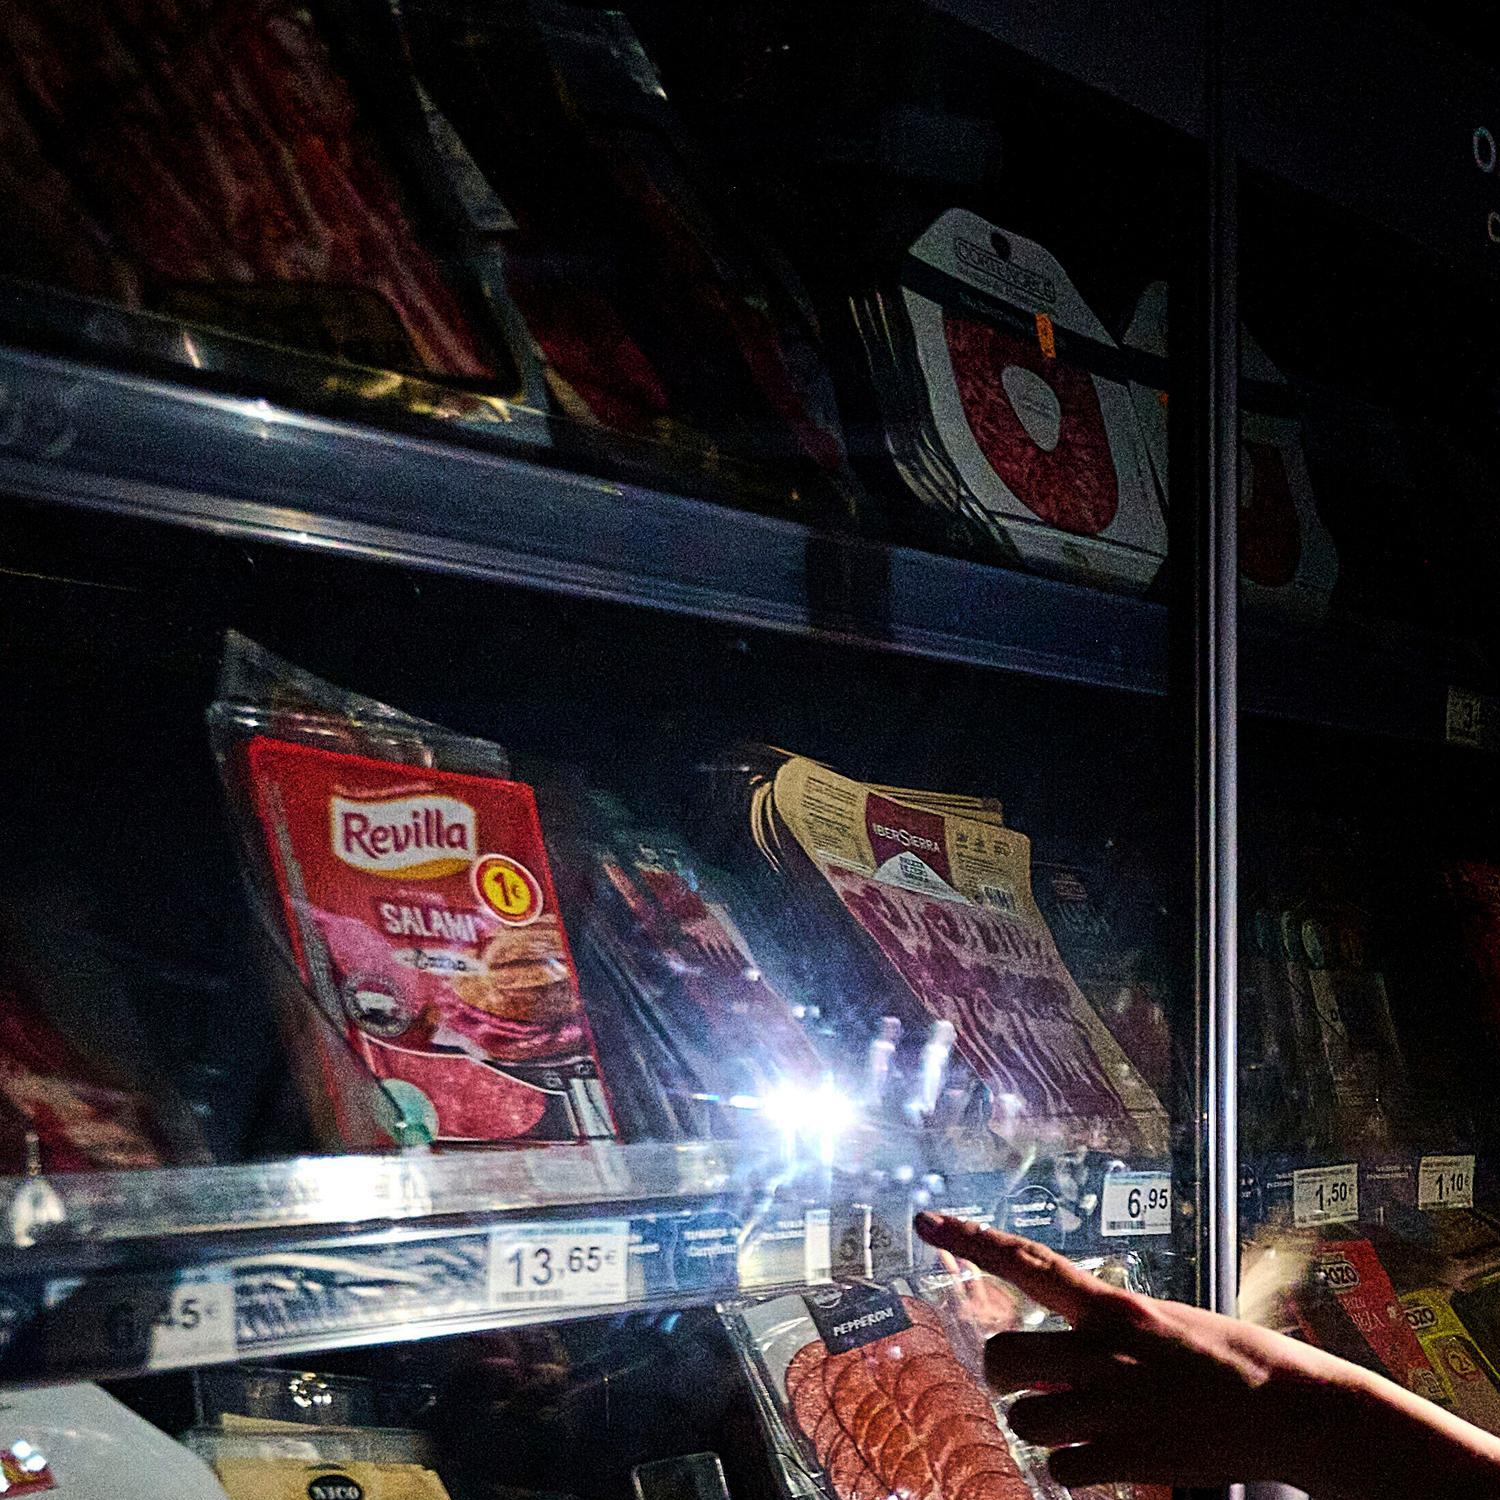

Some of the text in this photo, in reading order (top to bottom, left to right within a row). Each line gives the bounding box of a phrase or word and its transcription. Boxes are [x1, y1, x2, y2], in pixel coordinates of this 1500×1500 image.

[342, 809, 468, 859] Revilla
[380, 901, 479, 944] SALAMI
[832, 1305, 897, 1340] PEPPERONI
